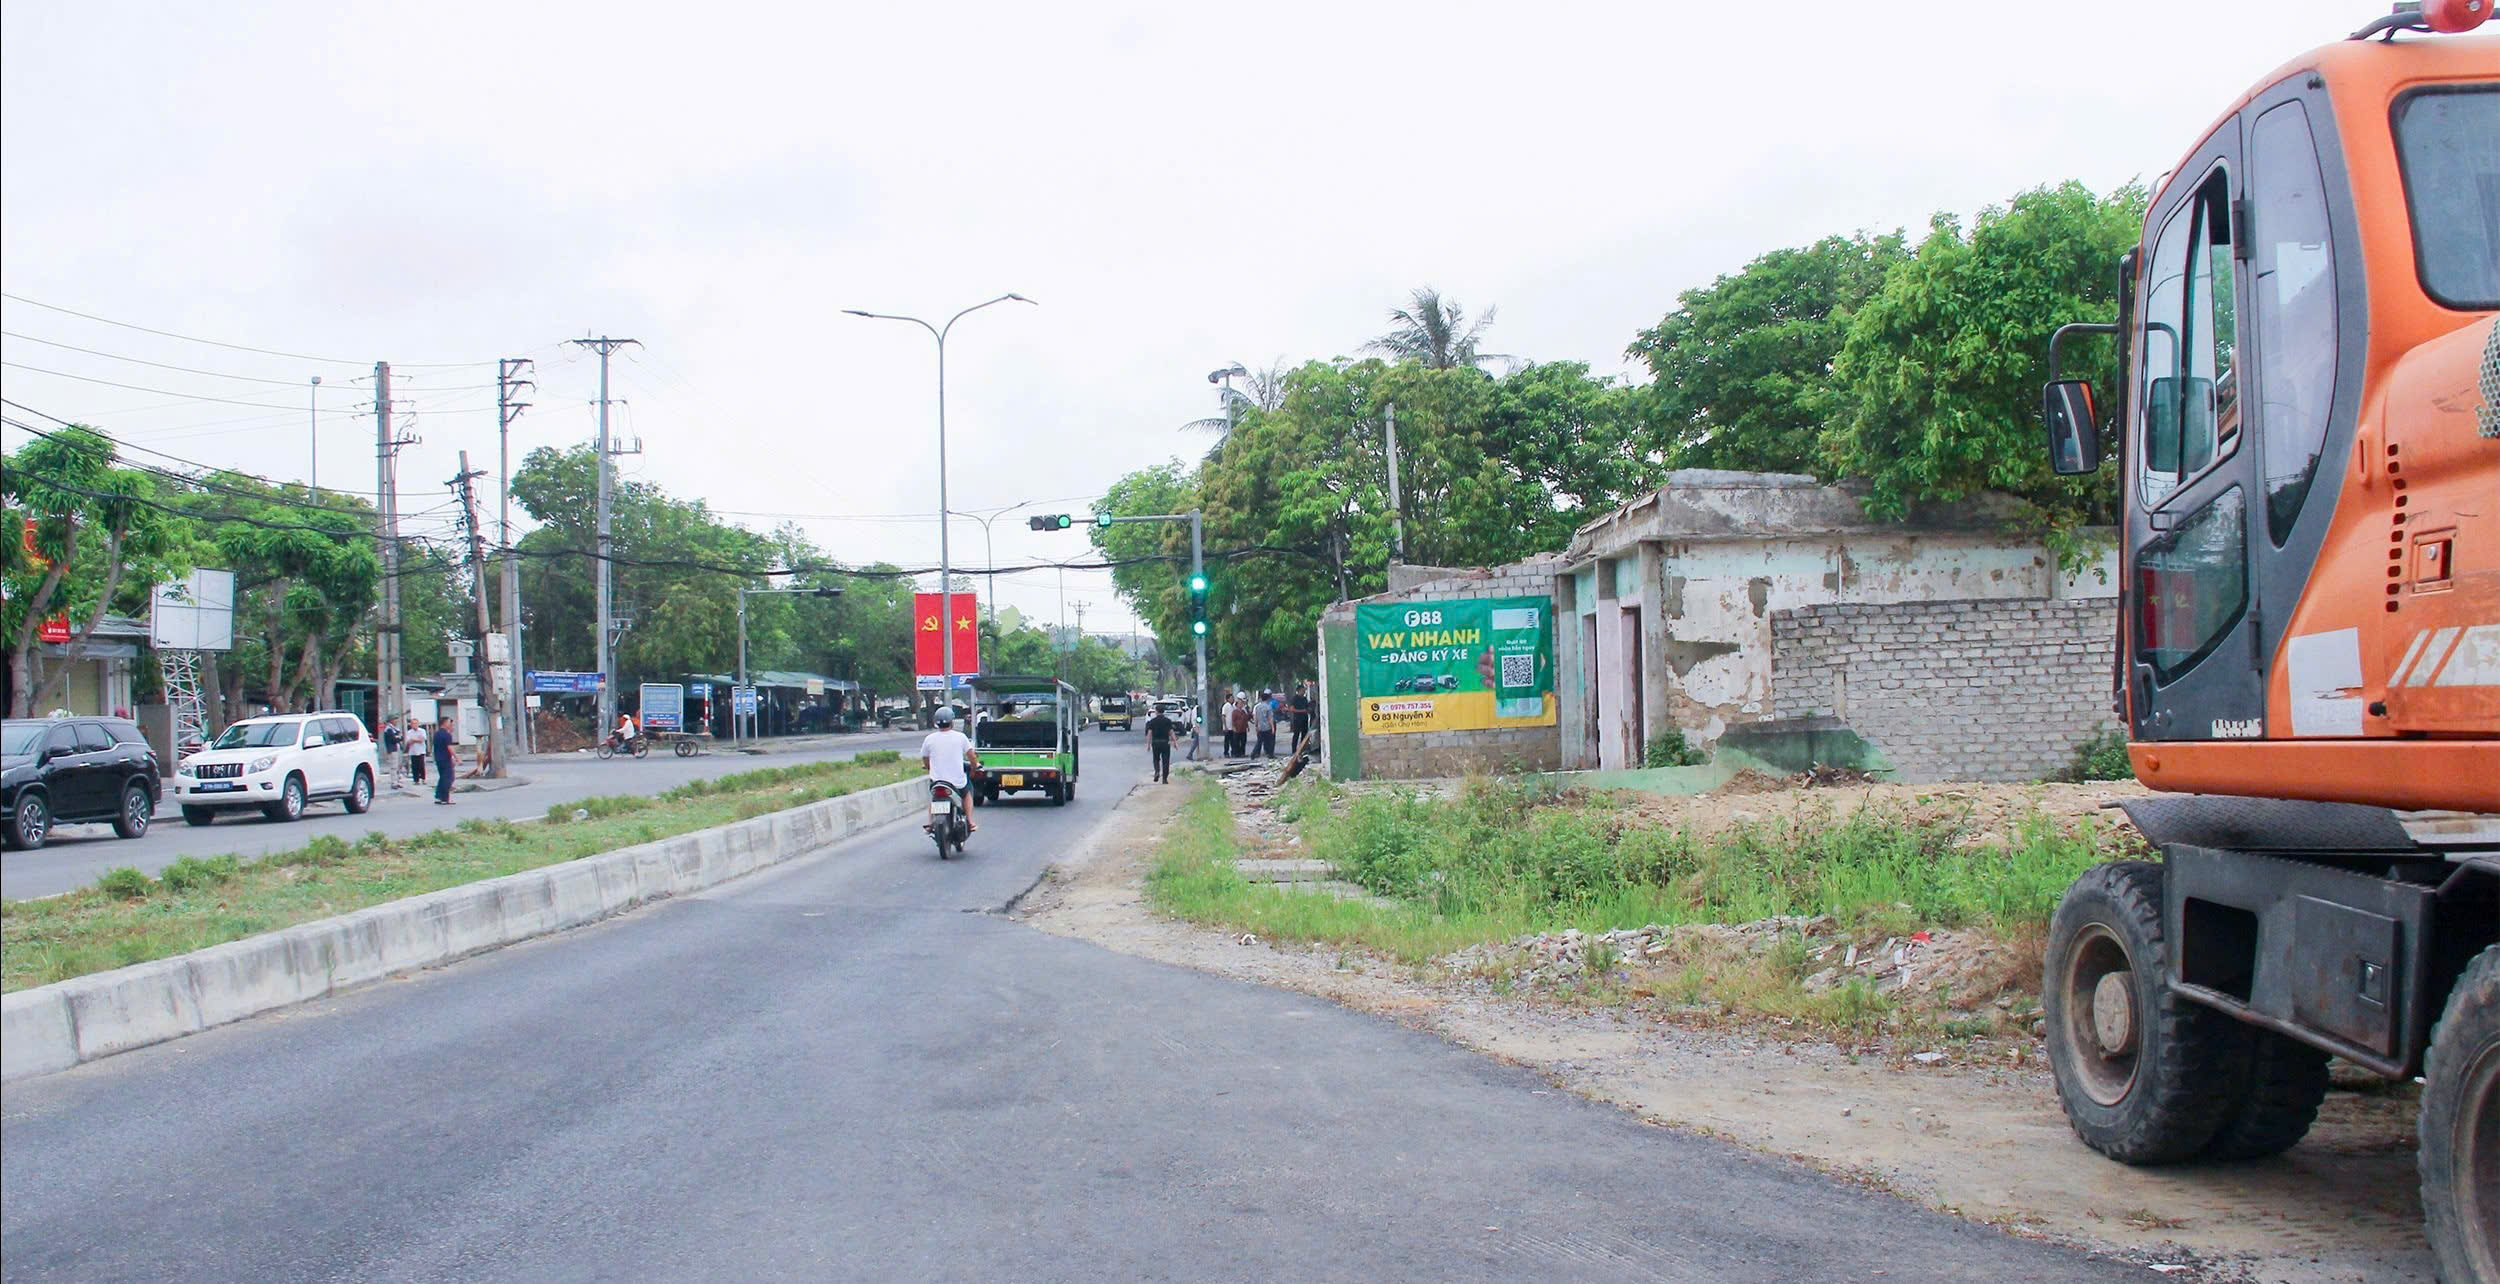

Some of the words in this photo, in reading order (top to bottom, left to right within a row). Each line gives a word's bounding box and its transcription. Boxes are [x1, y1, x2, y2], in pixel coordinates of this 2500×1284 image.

[1404, 610, 1442, 627] F88
[1368, 632, 1405, 650] VAY
[1410, 628, 1481, 648] NHANH
[1431, 647, 1448, 661] KÝ
[1452, 648, 1468, 660] XE
[1381, 713, 1391, 721] 83
[1393, 711, 1423, 721] Nguyễn
